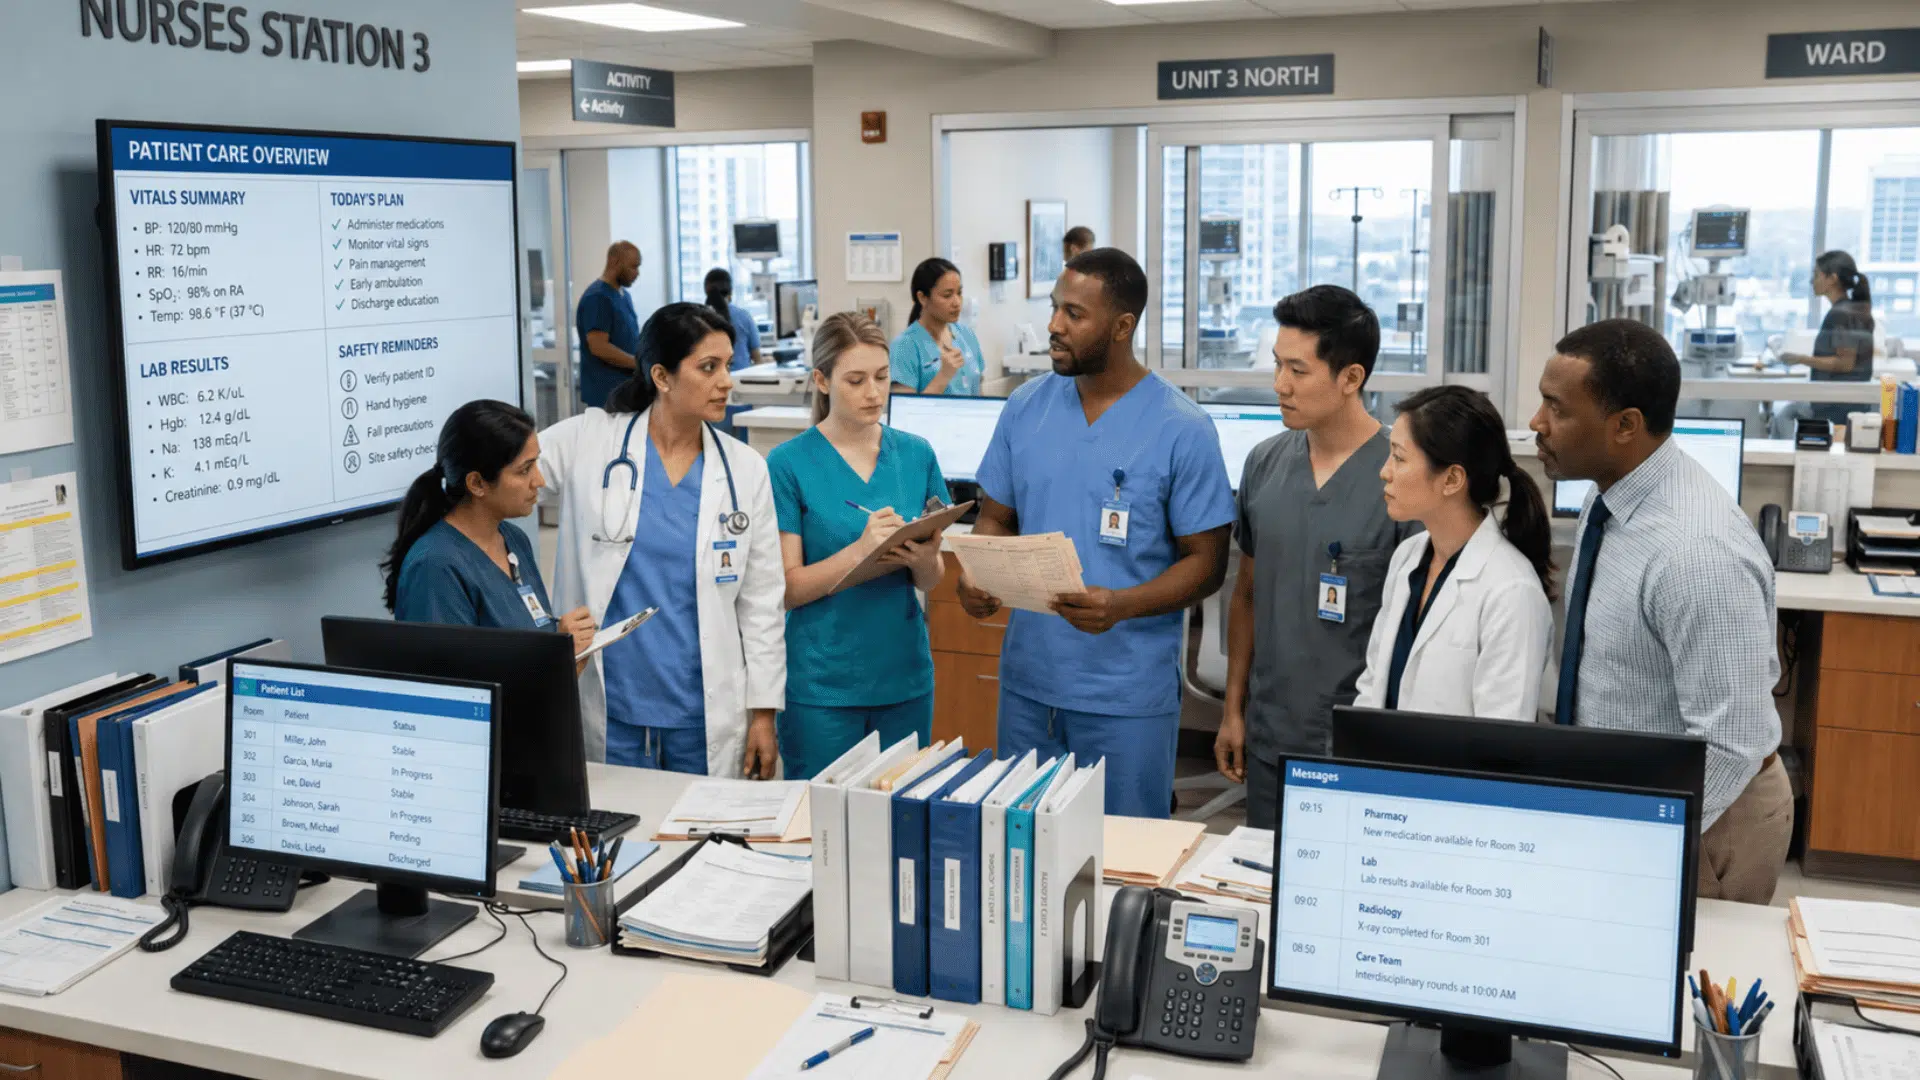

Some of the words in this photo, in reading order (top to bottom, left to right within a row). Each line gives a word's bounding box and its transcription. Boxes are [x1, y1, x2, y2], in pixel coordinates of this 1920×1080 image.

[81, 0, 250, 53] NURSES
[262, 11, 404, 69] STATION
[413, 31, 430, 72] 3
[1806, 41, 1886, 66] WARD
[607, 72, 651, 89] ACTIVITY
[1172, 70, 1222, 90] UNIT
[1226, 69, 1238, 88] 3
[1245, 65, 1319, 87] NORTH
[591, 99, 624, 118] Activity
[129, 140, 202, 162] PATIENT
[207, 144, 249, 163] CARE
[253, 145, 329, 166] OVERVIEW
[130, 190, 177, 205] VITALS
[180, 191, 245, 205] SUMMARY
[331, 192, 375, 206] TODAY'S
[378, 193, 404, 206] PLAN
[145, 222, 162, 234] BP:
[168, 222, 202, 234] 120/80
[205, 222, 237, 236] mmHg
[348, 219, 393, 230] Administer
[396, 218, 444, 229] medications
[146, 245, 164, 256] HR:
[171, 244, 183, 256] 72
[187, 244, 210, 258] bpm
[348, 239, 383, 250] Monitor
[386, 238, 404, 248] vital
[407, 239, 429, 251] signs
[148, 266, 165, 278] RR:
[172, 265, 207, 278] 16/min
[349, 259, 368, 269] Pain
[370, 258, 426, 271] management
[350, 278, 372, 291] Early
[375, 276, 423, 288] ambulation
[187, 286, 210, 298] 98%
[214, 288, 226, 297] on
[230, 285, 244, 296] RA
[351, 298, 395, 310] Discharge
[397, 294, 439, 307] education
[151, 310, 183, 323] Temp:
[189, 308, 211, 320] 98.6
[230, 305, 245, 319] (37
[339, 342, 378, 358] SAFETY
[382, 337, 438, 353] REMINDERS
[141, 362, 167, 378] LAB
[171, 356, 229, 374] RESULTS
[365, 372, 391, 385] Verify
[393, 369, 423, 384] patient
[426, 367, 434, 378] ID
[159, 393, 188, 406] WBC:
[197, 390, 214, 402] 6.2
[218, 387, 244, 399] K/uL
[367, 398, 390, 411] Hand
[393, 395, 427, 410] hygiene
[161, 417, 186, 432] Hgb:
[200, 412, 221, 424] 12.4
[225, 409, 250, 425] g/dL
[368, 426, 382, 438] Fall
[385, 420, 433, 438] precautions
[162, 444, 180, 455] Na:
[193, 436, 211, 450] 138
[215, 432, 251, 446] mEq/L
[369, 452, 385, 464] Site
[388, 447, 413, 459] safety
[164, 467, 174, 479] K:
[195, 461, 210, 472] 4.1
[215, 455, 249, 469] mEq/L
[165, 484, 221, 503] Creatinine:
[227, 478, 243, 490] 0.9
[246, 472, 280, 488] mg/dL
[261, 683, 288, 695] Patient
[291, 687, 305, 696] List
[244, 706, 264, 715] Room
[285, 710, 309, 720] Patient
[393, 720, 416, 731] Status
[244, 730, 256, 739] 301
[285, 734, 306, 745] Miller,
[308, 737, 326, 746] John
[243, 751, 256, 760] 302
[392, 746, 415, 757] Stable
[243, 772, 256, 782] 303
[392, 767, 399, 776] In
[401, 768, 433, 781] Progress
[1292, 768, 1339, 783] Messages
[283, 776, 297, 787] Lee,
[300, 778, 320, 788] David
[243, 793, 255, 801] 304
[391, 788, 414, 799] Stable
[282, 798, 315, 810] Johnson,
[318, 801, 340, 812] Sarah
[1300, 802, 1323, 813] 09:15
[242, 813, 255, 823] 305
[390, 810, 397, 818] In
[400, 811, 432, 824] Progress
[1364, 808, 1408, 823] Pharmacy
[282, 819, 307, 830] Brown,
[309, 822, 339, 833] Michael
[241, 834, 255, 843] 306
[389, 832, 421, 846] Pending
[1364, 827, 1382, 837] New
[1385, 829, 1432, 843] medication
[1435, 834, 1473, 847] available
[1475, 837, 1488, 848] for
[1491, 839, 1516, 851] Room
[1518, 842, 1535, 853] 302
[282, 839, 303, 851] Davis,
[305, 842, 325, 853] Linda
[389, 853, 431, 867] Discharged
[1298, 849, 1320, 860] 09:07
[1362, 856, 1377, 866] Lab
[1361, 874, 1376, 884] Lab
[1379, 875, 1408, 887] results
[1410, 879, 1448, 892] available
[1450, 883, 1464, 894] for
[1466, 885, 1492, 897] Room
[1495, 887, 1512, 899] 303
[1359, 903, 1402, 919] Radiology
[1358, 921, 1380, 934] X-ray
[1383, 925, 1428, 940] completed
[1430, 929, 1443, 940] for
[1446, 932, 1471, 944] Room
[1474, 934, 1490, 945] 301
[1356, 951, 1376, 963] Care
[1379, 954, 1402, 966] Team
[1355, 969, 1424, 989] Interdisciplinary
[1427, 979, 1458, 992] rounds
[1460, 984, 1470, 993] at
[1473, 985, 1498, 998] 10:00
[1500, 988, 1516, 1000] AM
